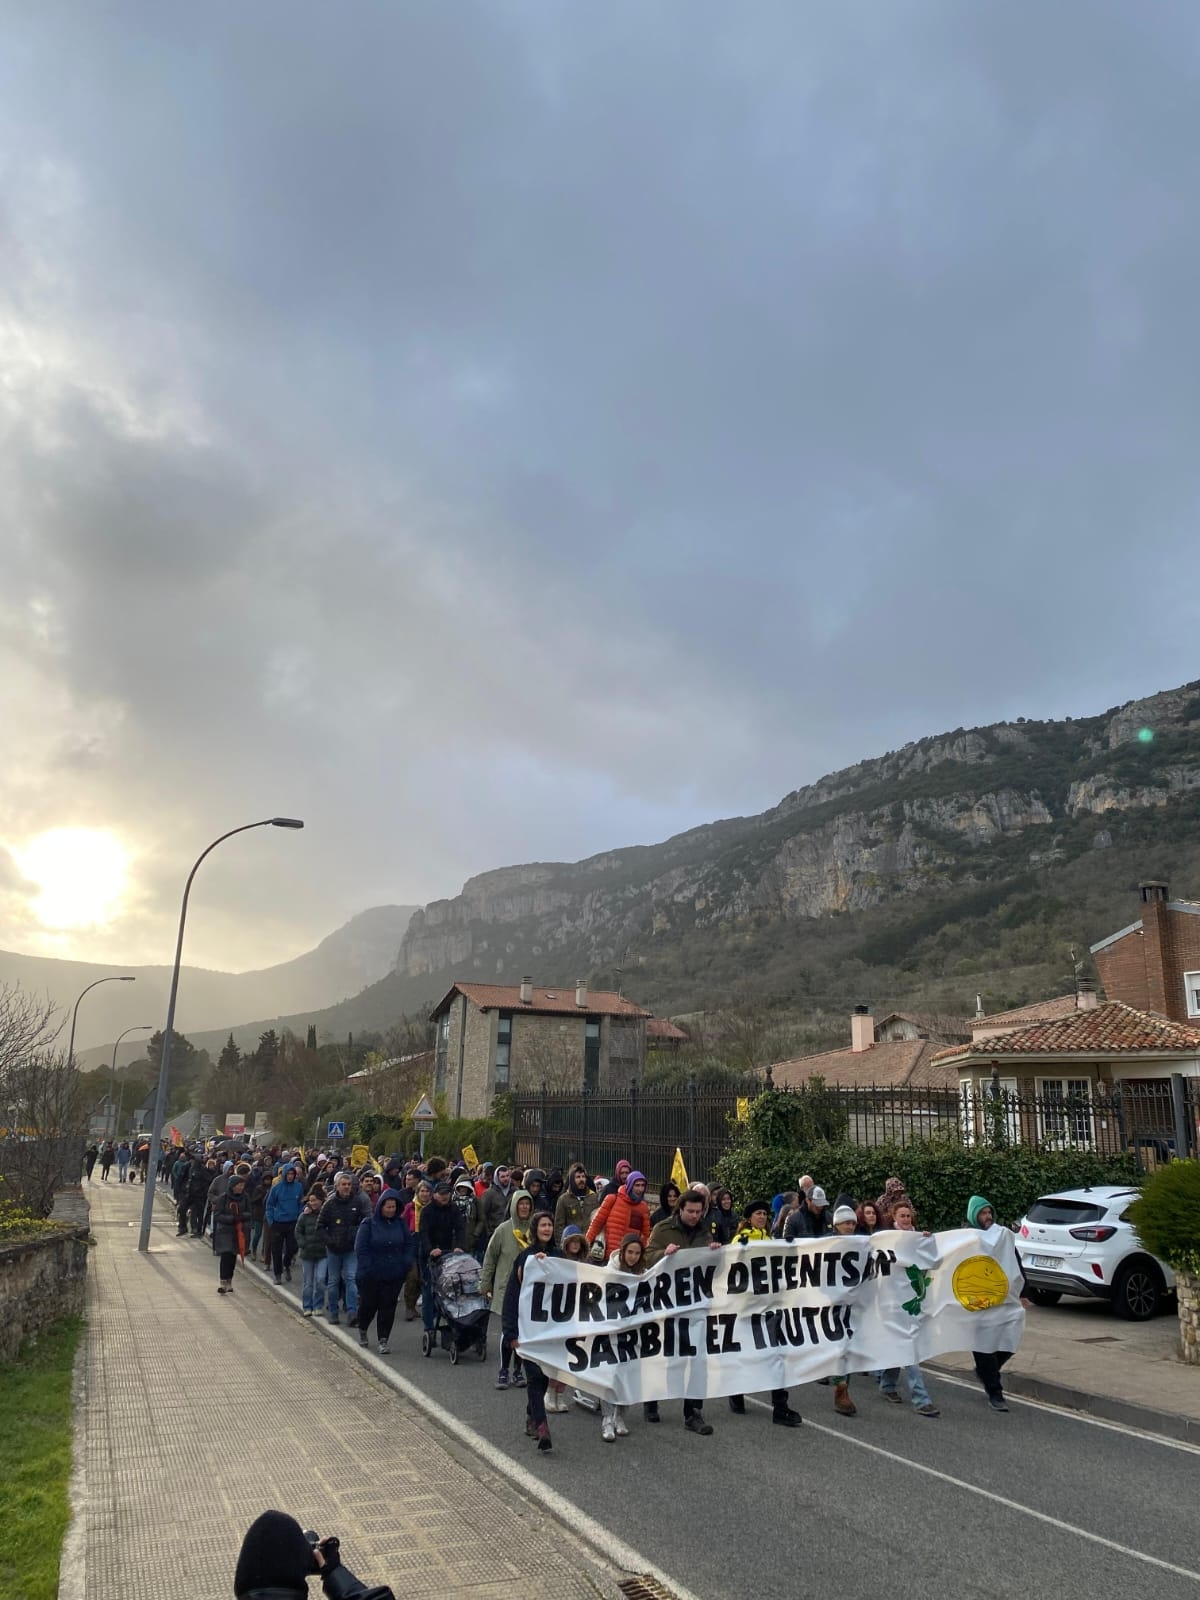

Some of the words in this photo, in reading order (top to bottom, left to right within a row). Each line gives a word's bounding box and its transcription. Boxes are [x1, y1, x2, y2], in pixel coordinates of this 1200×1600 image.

[530, 1265, 717, 1323] LURRAREN
[726, 1249, 897, 1296] DEFENTSAN
[565, 1317, 697, 1373] SARBIL
[706, 1313, 741, 1355] EZ
[751, 1304, 854, 1350] IKUTU!
